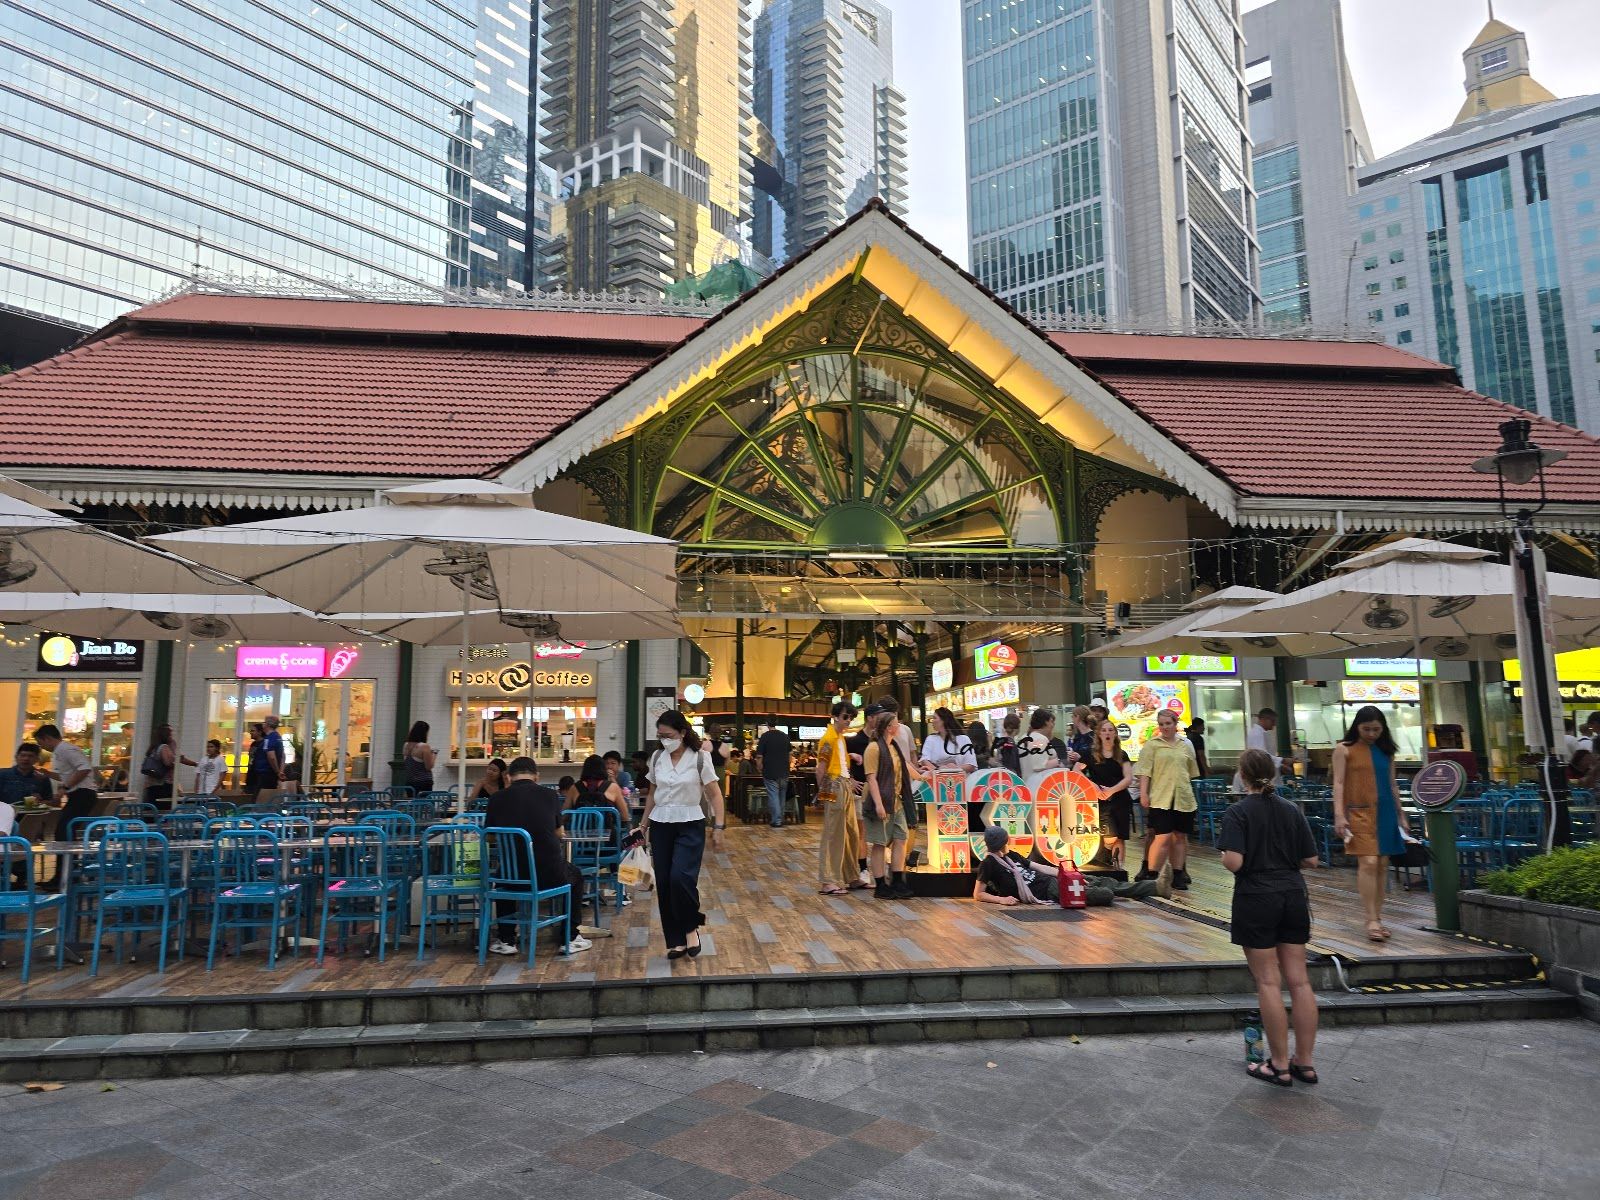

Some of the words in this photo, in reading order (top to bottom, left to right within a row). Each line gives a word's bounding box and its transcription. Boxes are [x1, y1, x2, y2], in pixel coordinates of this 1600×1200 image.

[79, 640, 112, 655] Jian
[113, 641, 137, 655] Bo
[244, 657, 278, 665] creme
[290, 657, 318, 665] cone
[452, 671, 495, 685] Hook
[535, 672, 590, 685] Coffee
[1016, 736, 1055, 758] Sat
[1067, 824, 1109, 836] YEARS
